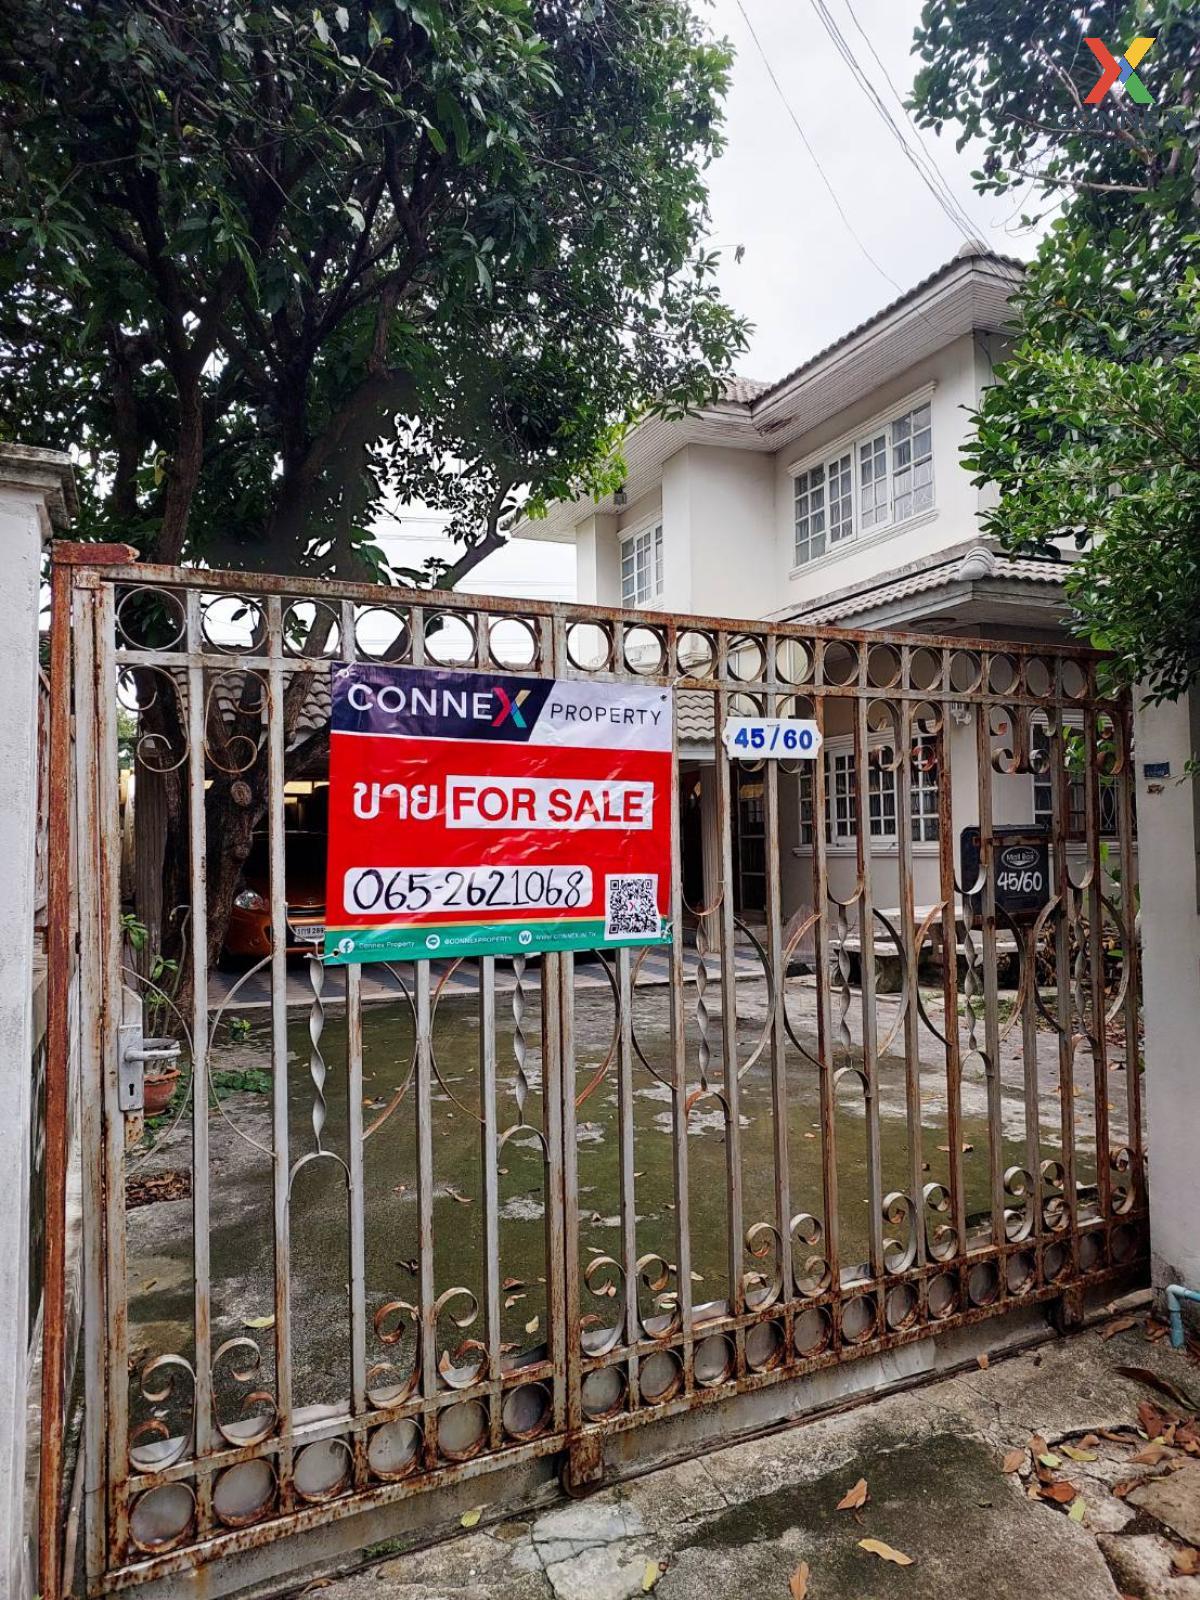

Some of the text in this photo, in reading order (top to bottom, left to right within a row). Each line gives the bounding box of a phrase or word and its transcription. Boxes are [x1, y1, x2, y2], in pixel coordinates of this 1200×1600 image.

[347, 683, 663, 728] CONNEX PROPERTY
[734, 724, 813, 751] 45/60
[353, 781, 438, 821] ขาย
[452, 785, 644, 824] FOR SALE
[352, 868, 584, 912] 065-2621068
[997, 870, 1043, 893] 45/60
